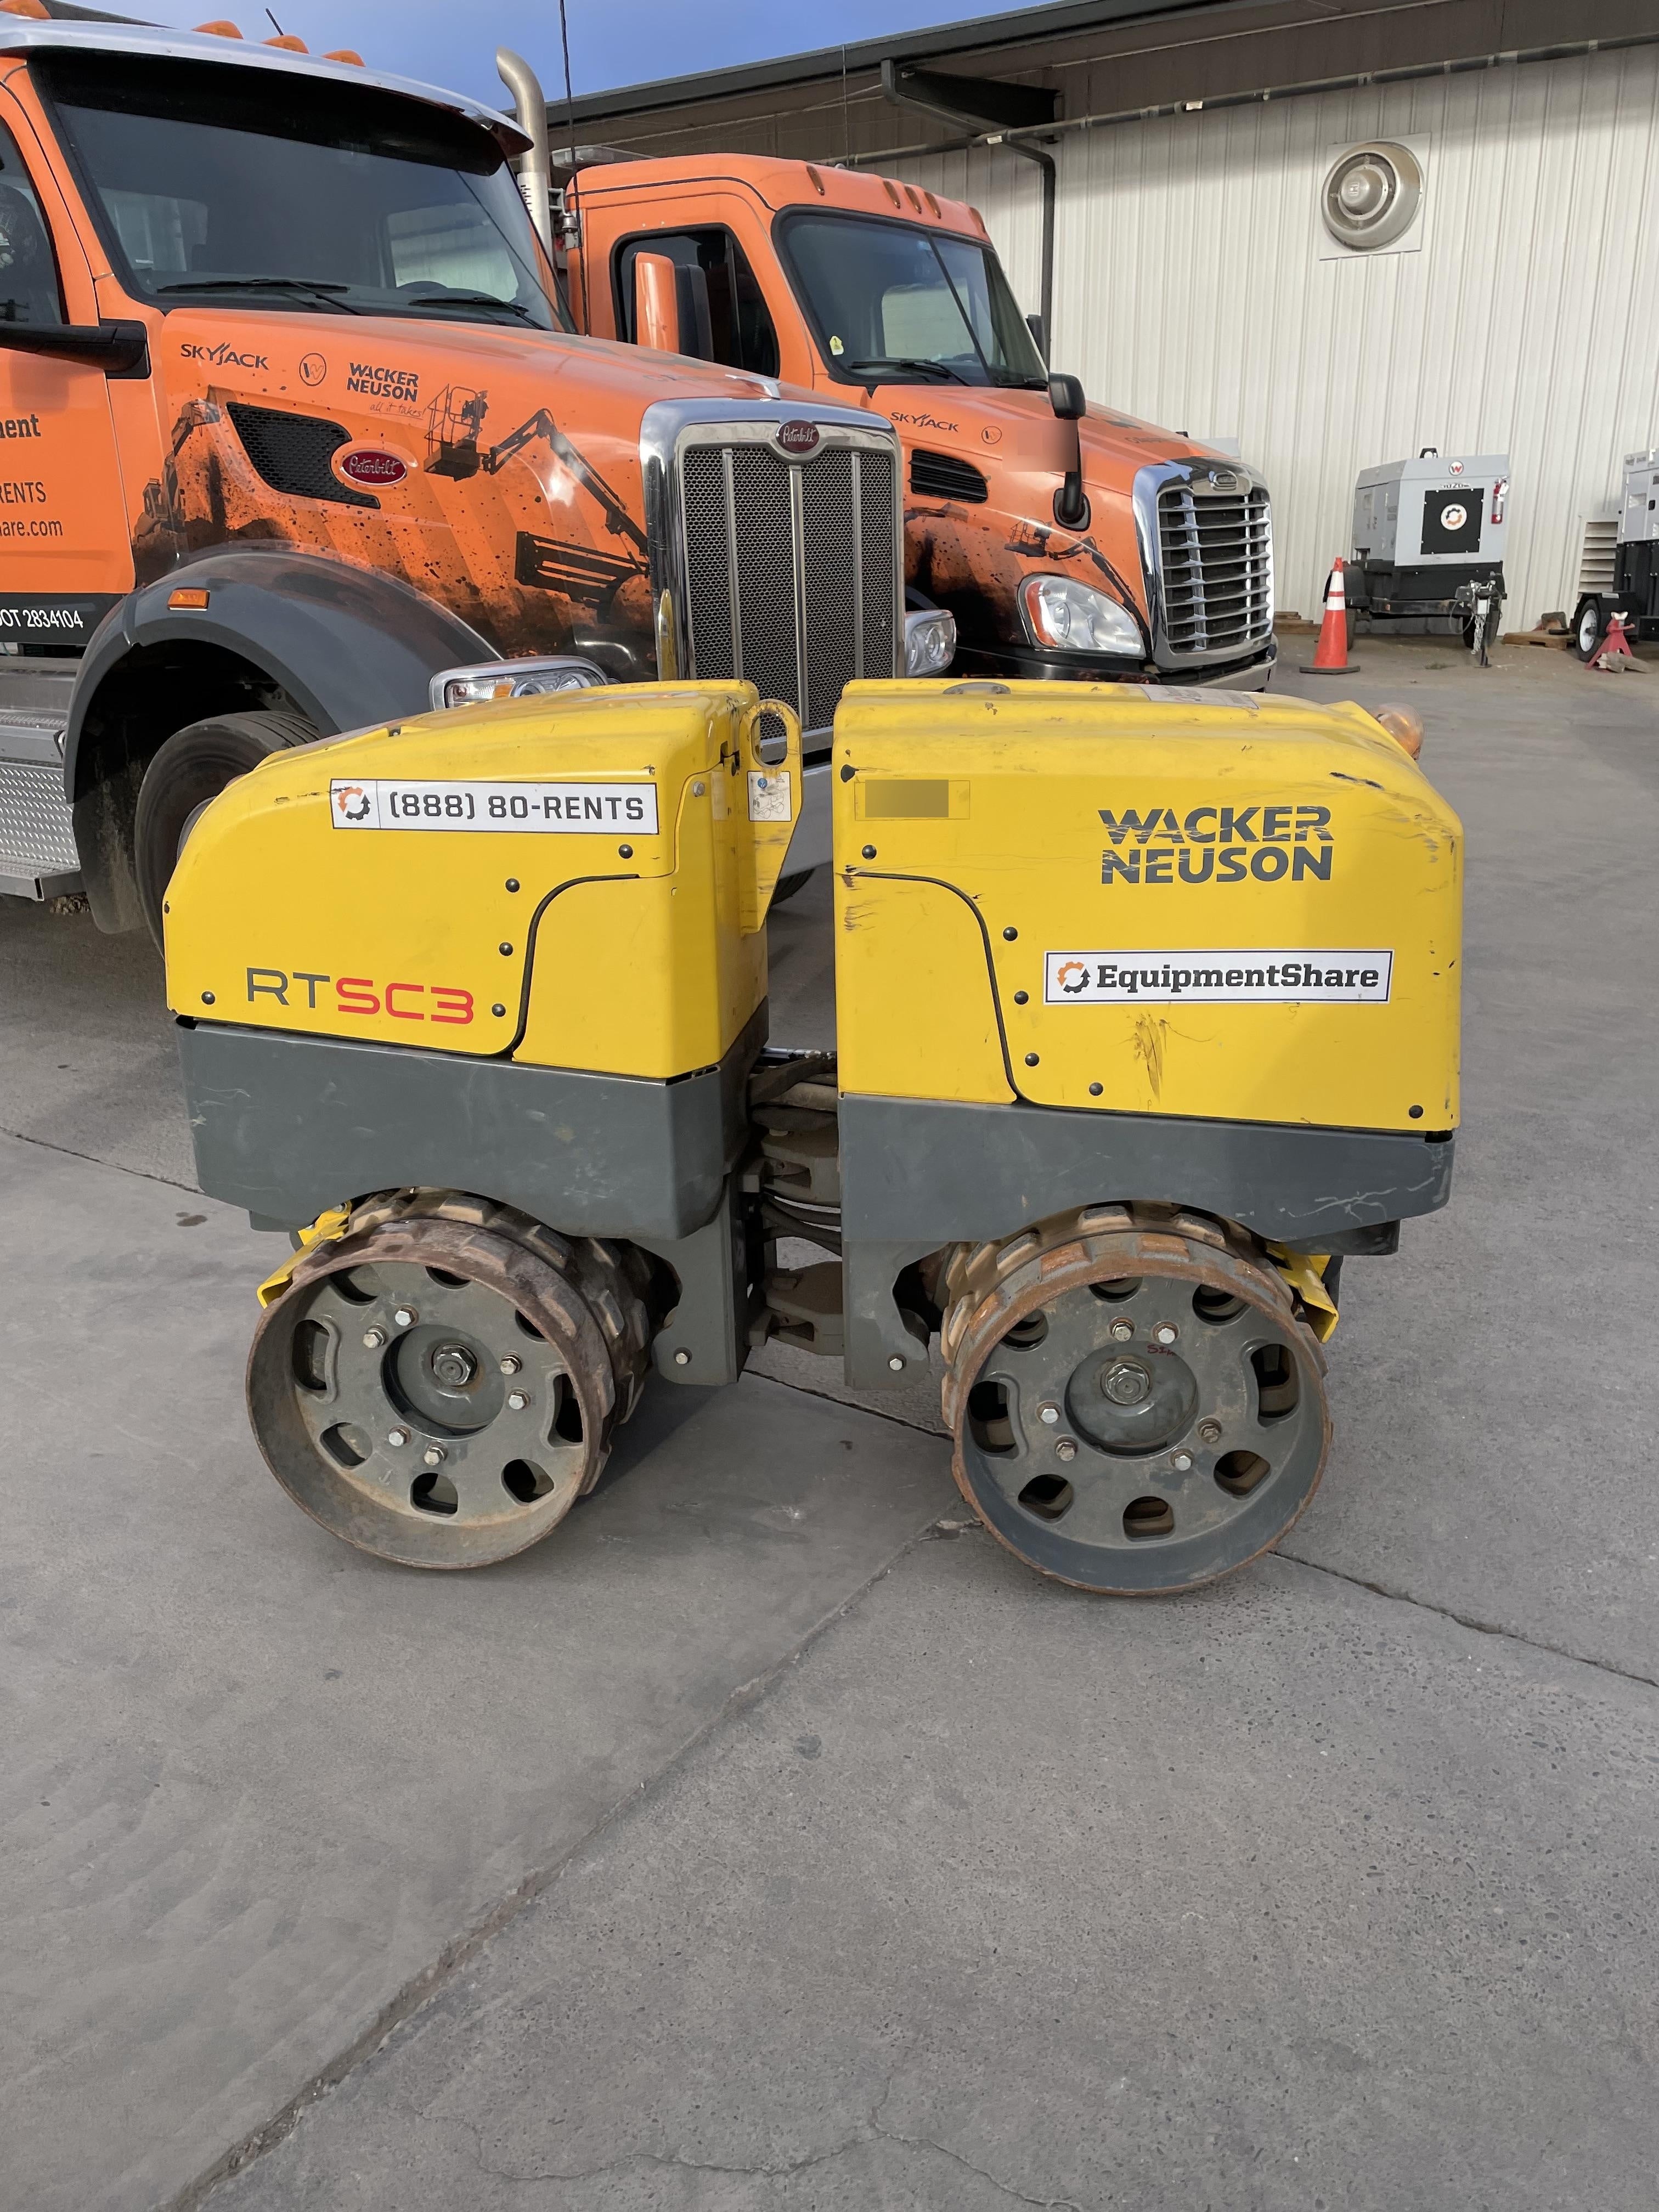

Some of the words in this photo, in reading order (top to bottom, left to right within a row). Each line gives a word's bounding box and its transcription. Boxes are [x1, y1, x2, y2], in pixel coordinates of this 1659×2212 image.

[180, 342, 269, 370] SKYJACK
[349, 363, 419, 387] WACKER
[347, 377, 418, 402] NEUSON
[783, 425, 817, 444] Peterbilt
[890, 412, 959, 432] SKYJACK
[349, 455, 400, 475] Peterbilt
[0, 521, 63, 537] are.com
[0, 609, 21, 627] OT
[22, 610, 83, 628] 2834104
[390, 793, 475, 820] (888)
[488, 795, 644, 820] 80-RENTS
[1097, 806, 1335, 844] WACKER
[1101, 845, 1333, 884] NEUSON
[1097, 964, 1379, 994] EquipmentShare
[246, 967, 474, 1025] RTSC3
